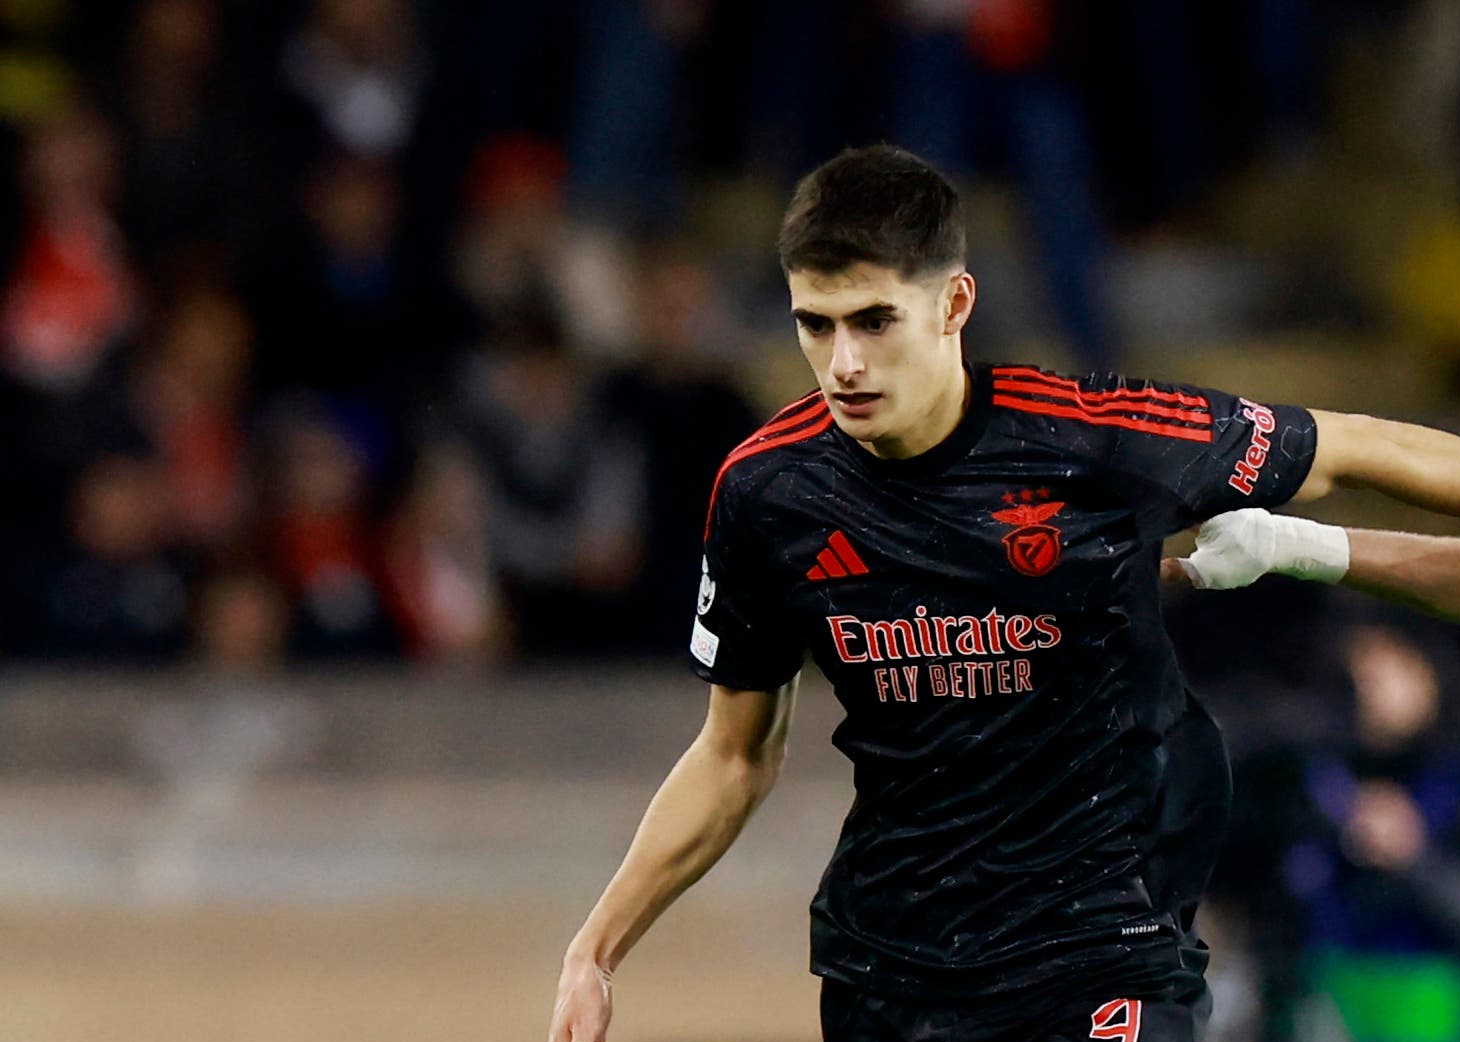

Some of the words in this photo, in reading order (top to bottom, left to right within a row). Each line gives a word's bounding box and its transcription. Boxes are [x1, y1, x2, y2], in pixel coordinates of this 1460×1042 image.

[826, 605, 1062, 663] Emirates
[874, 665, 918, 702] FLY
[929, 658, 1033, 698] BETTER
